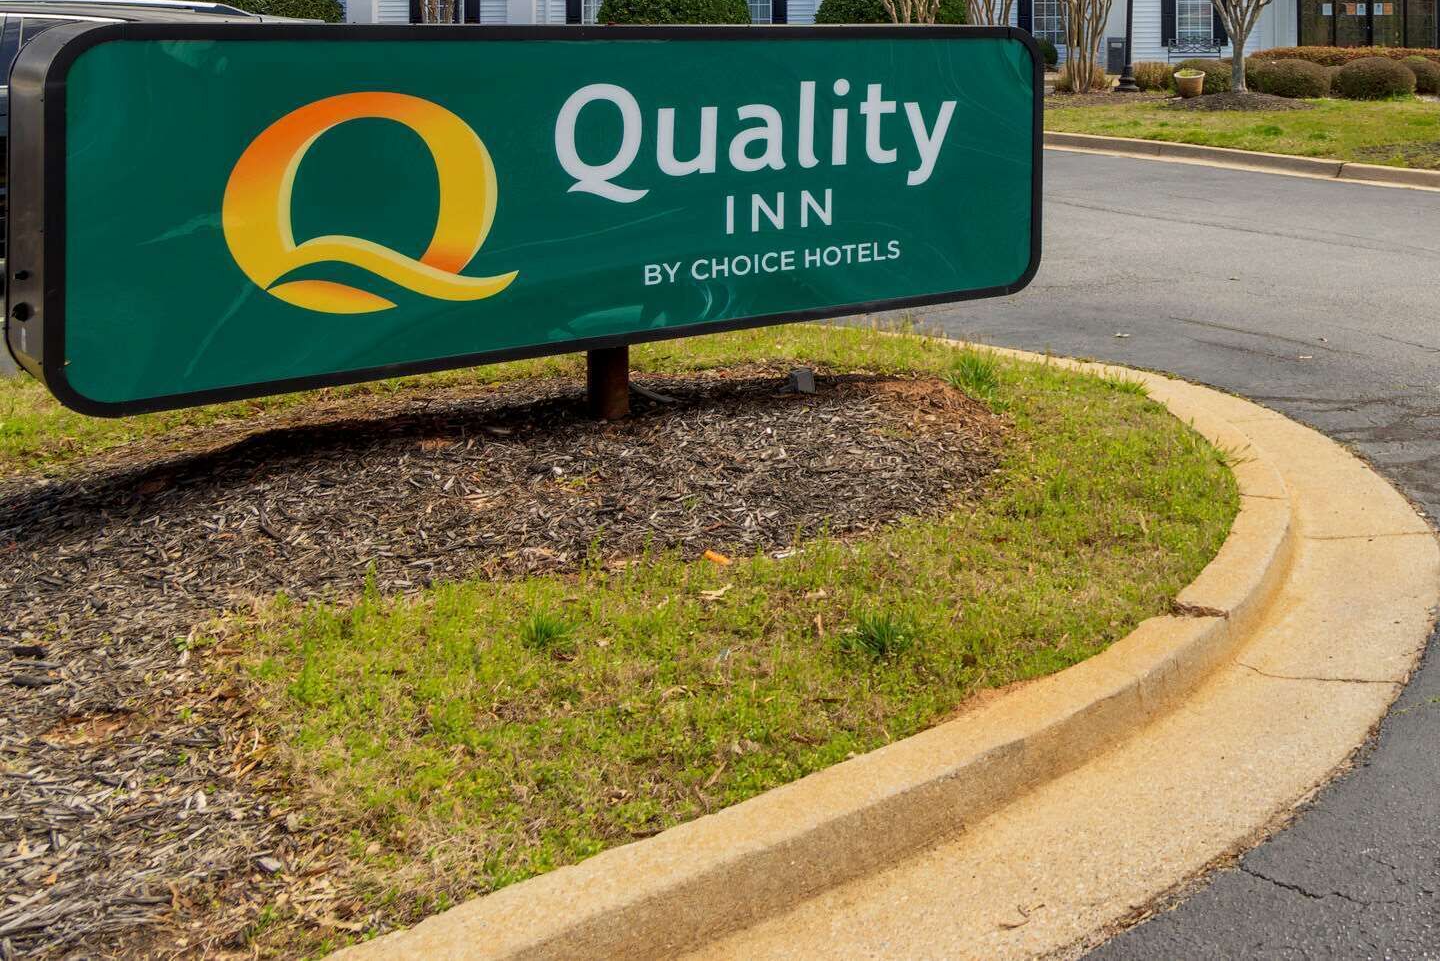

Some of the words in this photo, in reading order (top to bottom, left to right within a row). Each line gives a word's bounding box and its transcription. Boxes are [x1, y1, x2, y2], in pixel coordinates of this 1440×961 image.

[554, 78, 958, 204] Quality
[222, 91, 519, 314] Q
[725, 188, 833, 235] INN
[644, 261, 682, 286] BY
[691, 250, 796, 280] CHOICE
[804, 240, 901, 269] HOTELS
